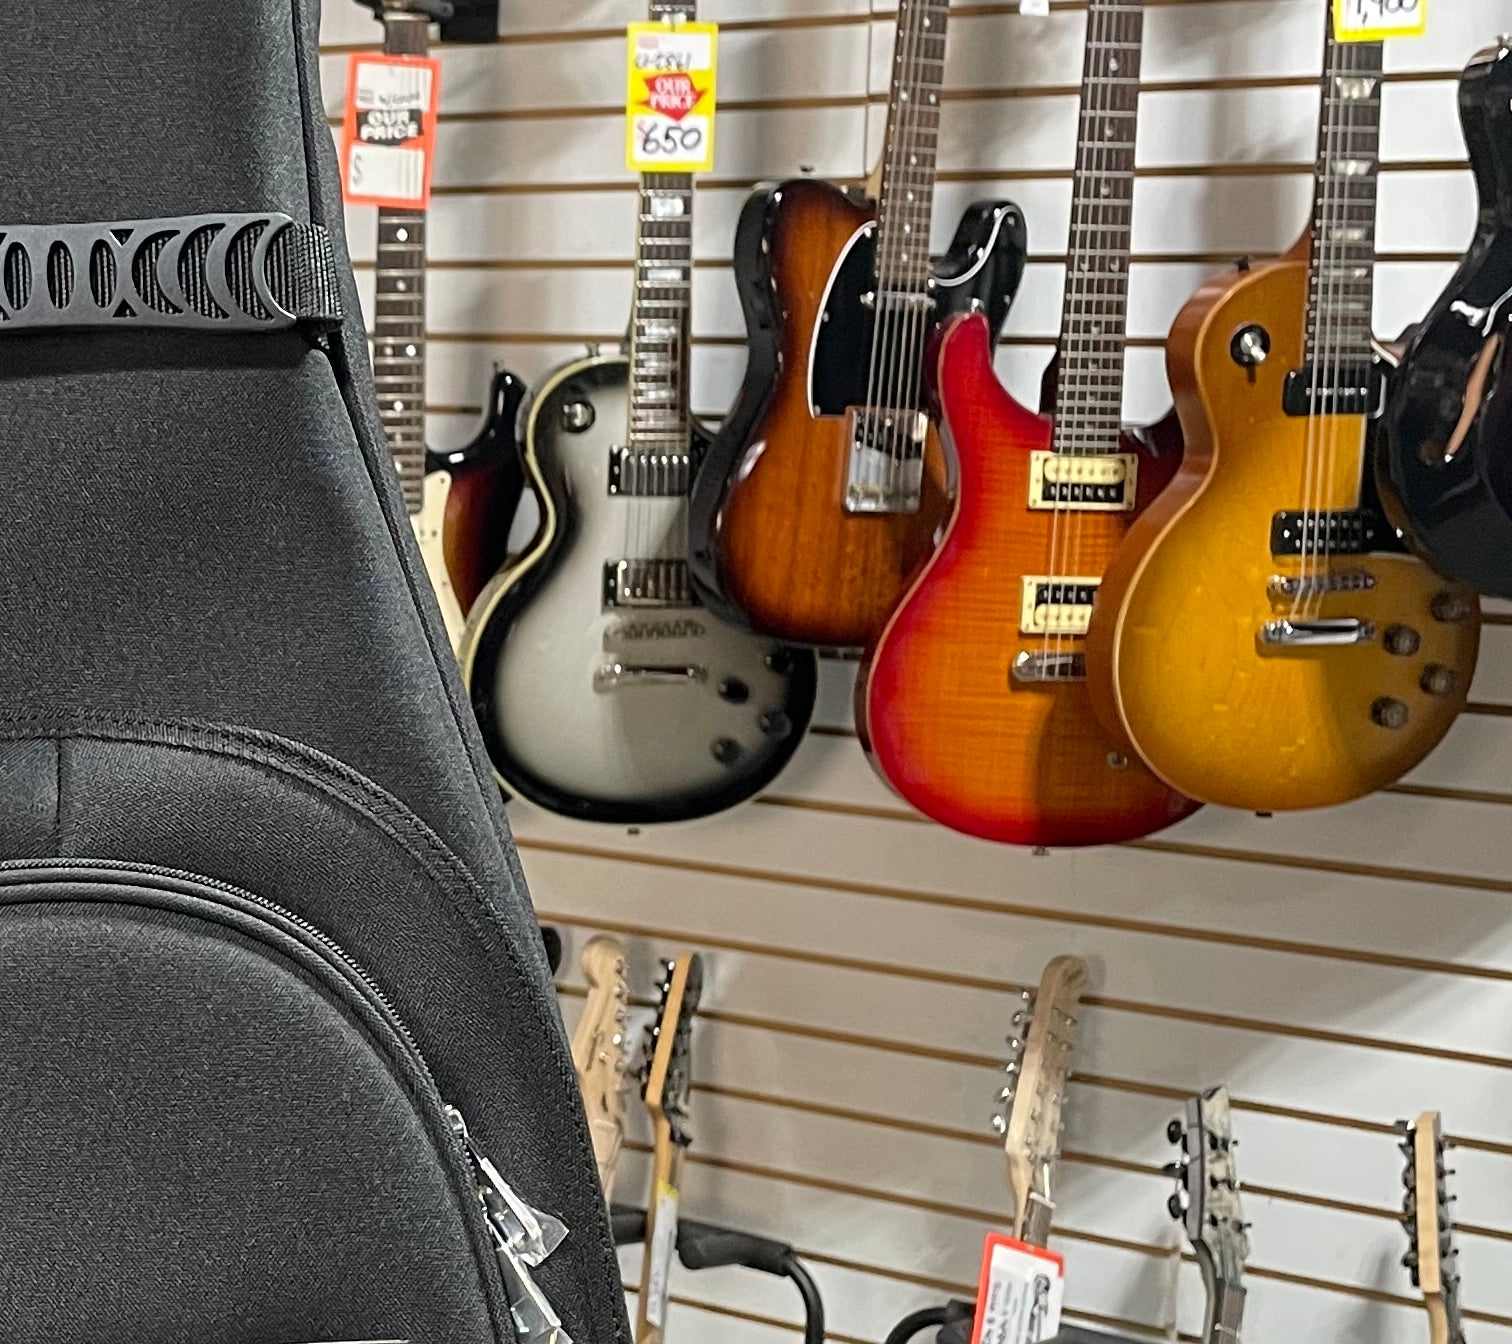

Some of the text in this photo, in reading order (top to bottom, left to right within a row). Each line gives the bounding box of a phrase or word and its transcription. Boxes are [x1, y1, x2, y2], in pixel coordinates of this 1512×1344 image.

[654, 76, 692, 96] OUR
[649, 93, 695, 110] PRICE
[367, 110, 411, 127] OUR
[360, 122, 418, 140] PRICE
